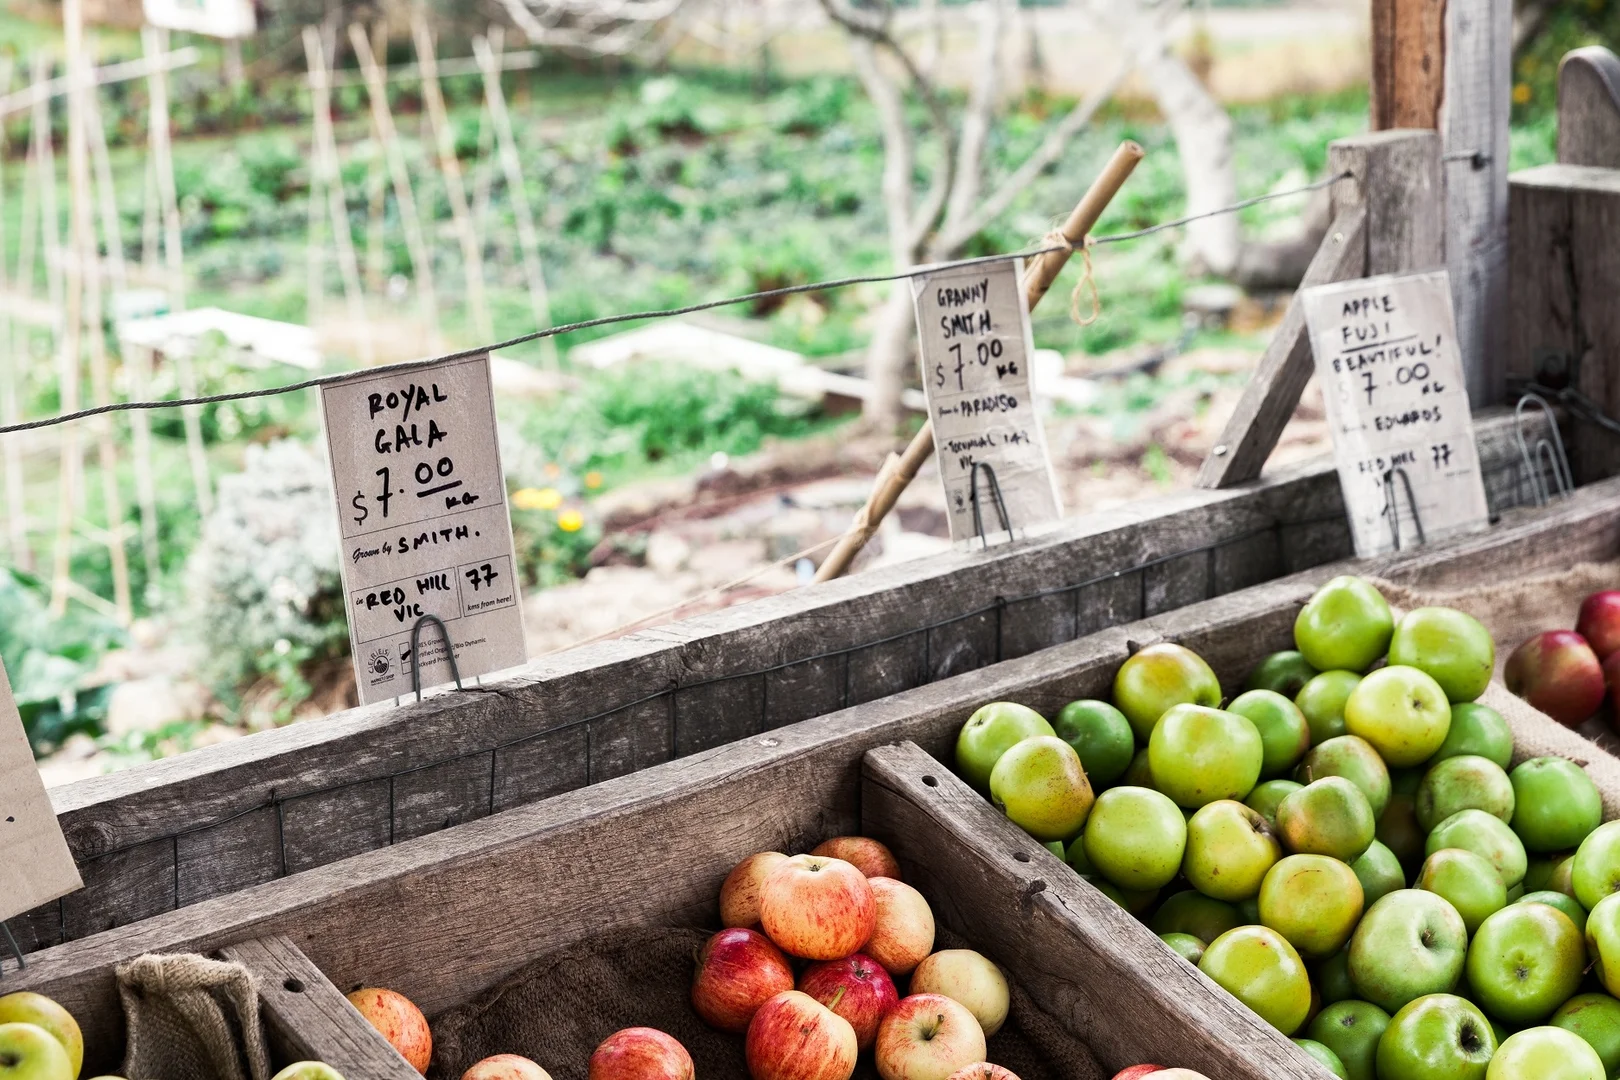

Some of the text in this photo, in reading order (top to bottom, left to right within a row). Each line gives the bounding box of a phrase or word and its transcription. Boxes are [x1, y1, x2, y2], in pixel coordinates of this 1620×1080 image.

[937, 277, 989, 308] GRANNY
[1342, 294, 1396, 319] APPLE
[940, 309, 992, 339] SMITH
[1341, 321, 1390, 345] FUJI
[368, 384, 448, 422] ROYAL
[960, 393, 1018, 417] PARADISO
[1374, 405, 1443, 431] EDWARDS
[375, 419, 448, 453] GALA
[1431, 442, 1454, 470] 77
[352, 547, 380, 564] Grown
[382, 541, 393, 555] by
[465, 563, 499, 591] 77
[355, 573, 451, 611] in RED HILL
[467, 594, 512, 612] kms from here!
[393, 602, 425, 623] VIC
[464, 637, 487, 647] Dynamic
